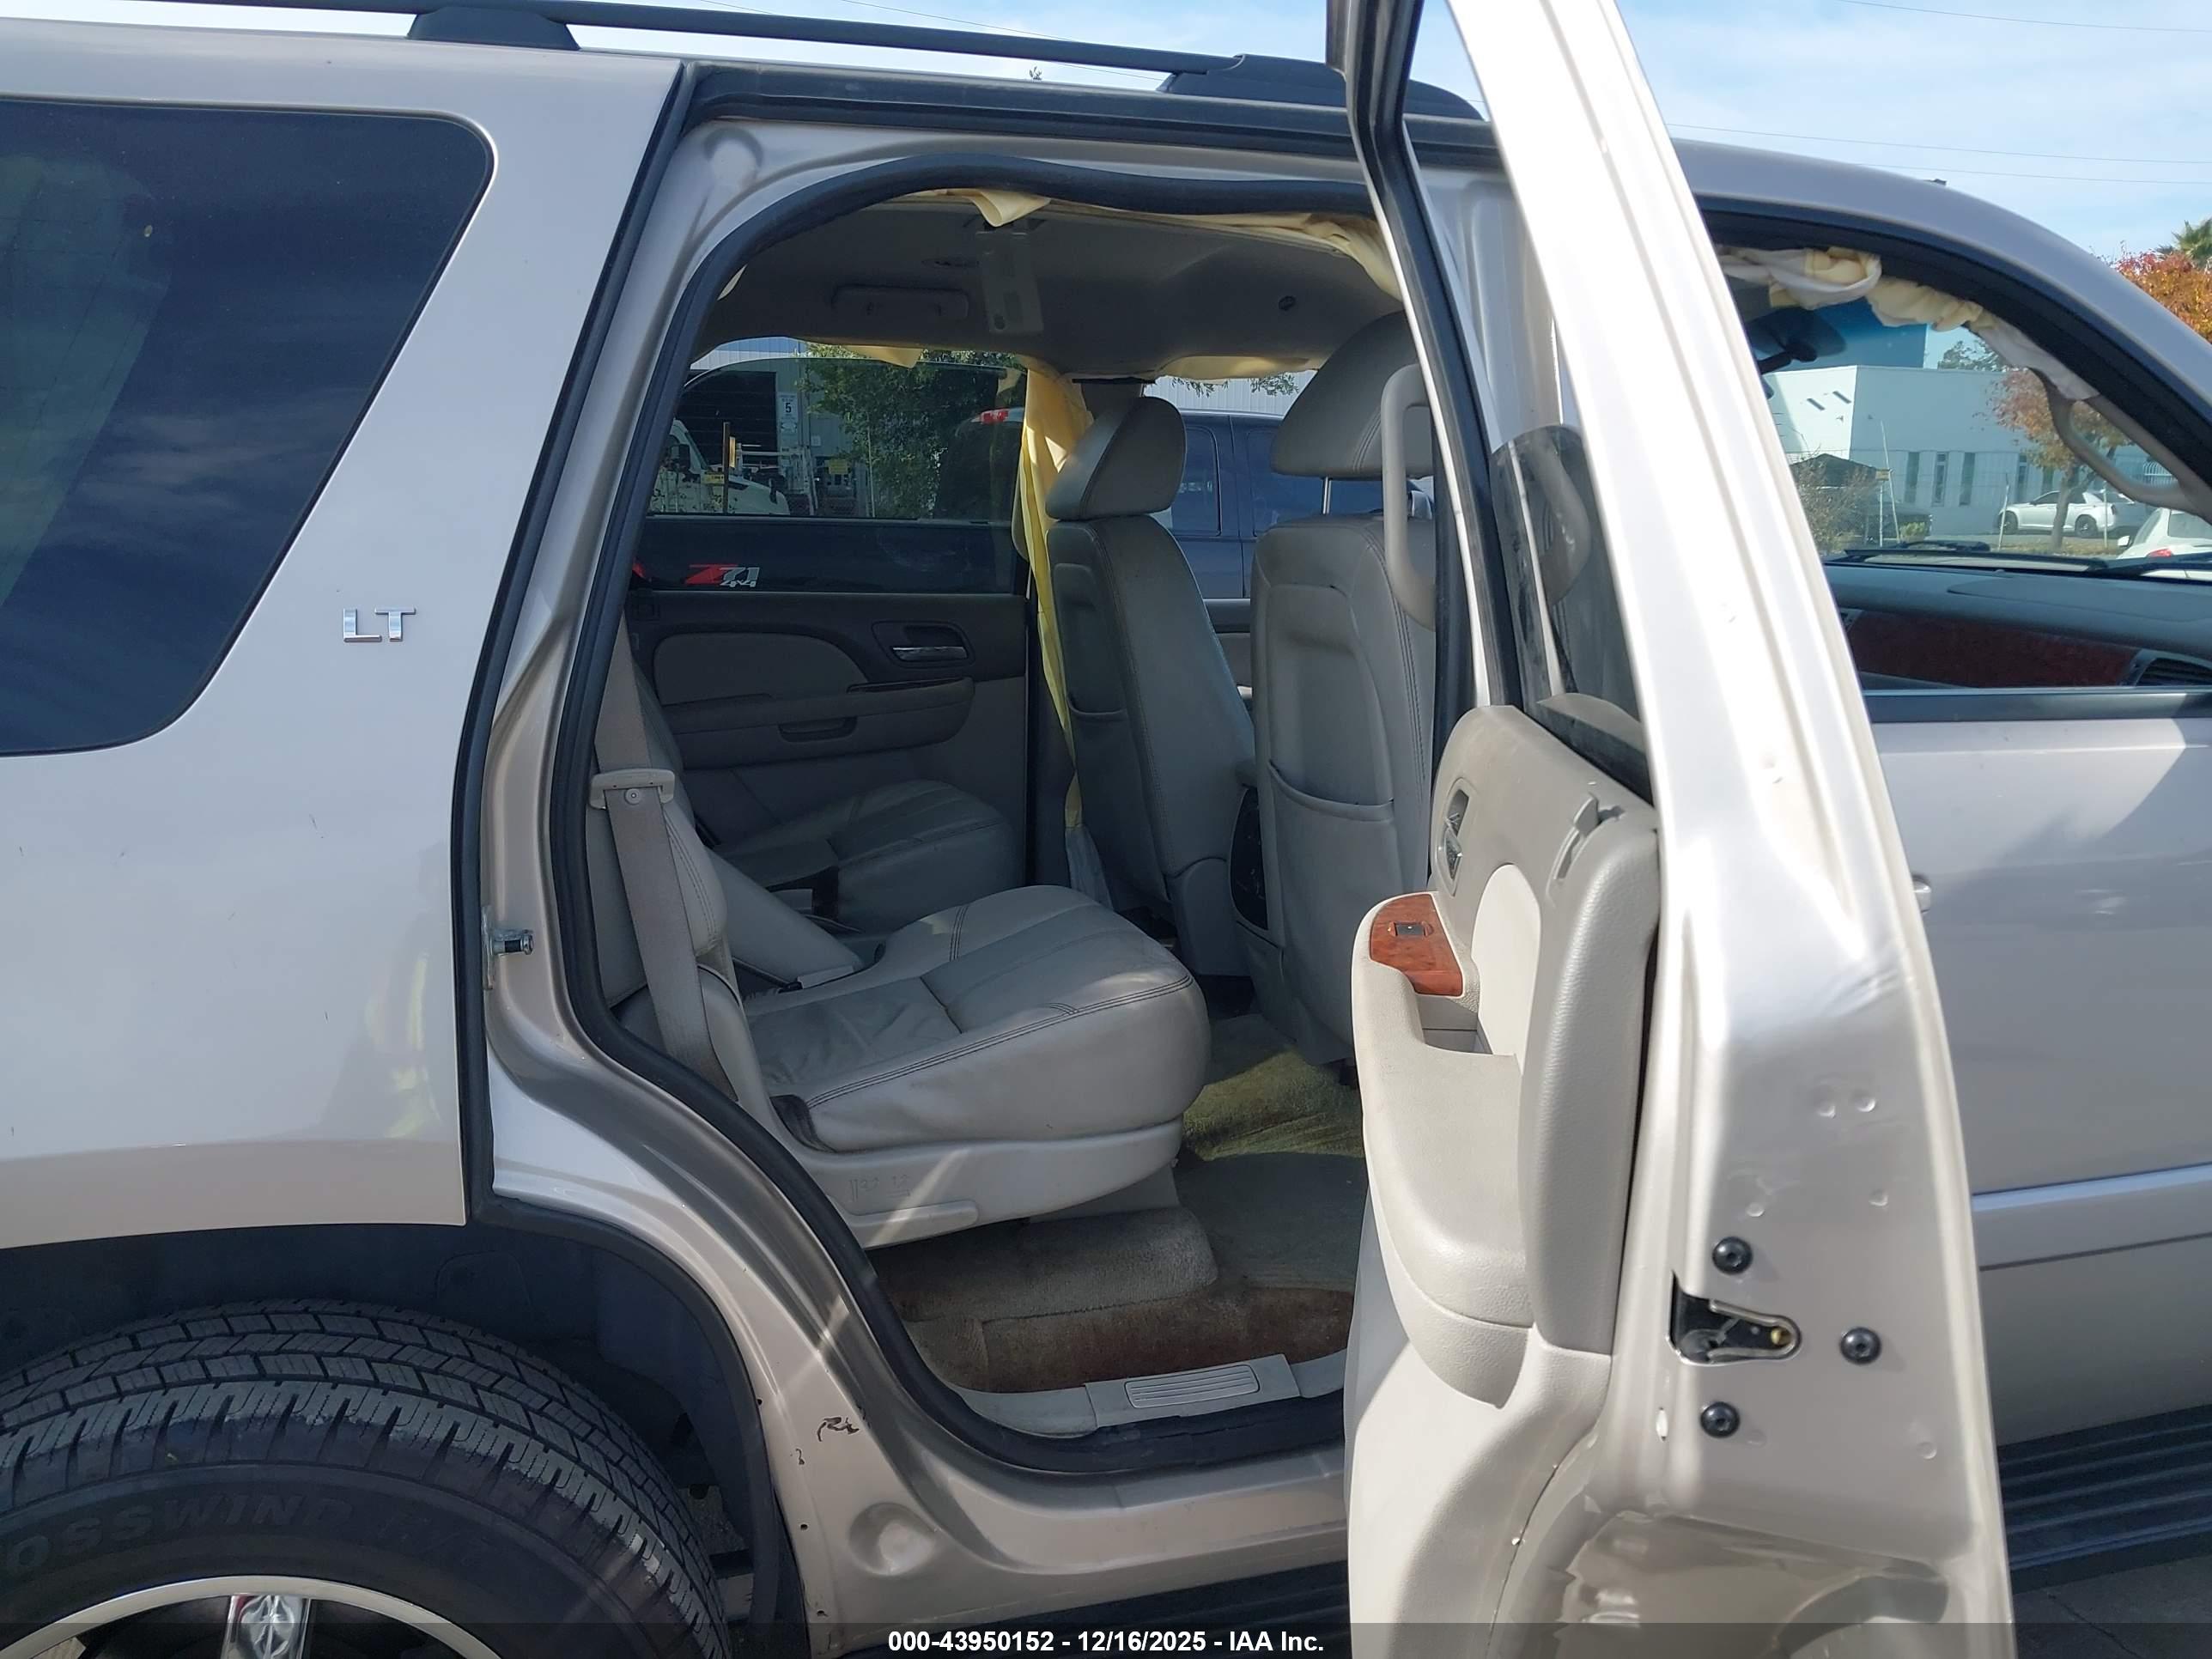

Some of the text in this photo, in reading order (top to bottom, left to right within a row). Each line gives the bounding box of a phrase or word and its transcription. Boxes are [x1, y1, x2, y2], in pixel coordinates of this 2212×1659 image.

[785, 402, 792, 413] 5
[684, 563, 760, 585] Z71
[343, 606, 416, 643] LT
